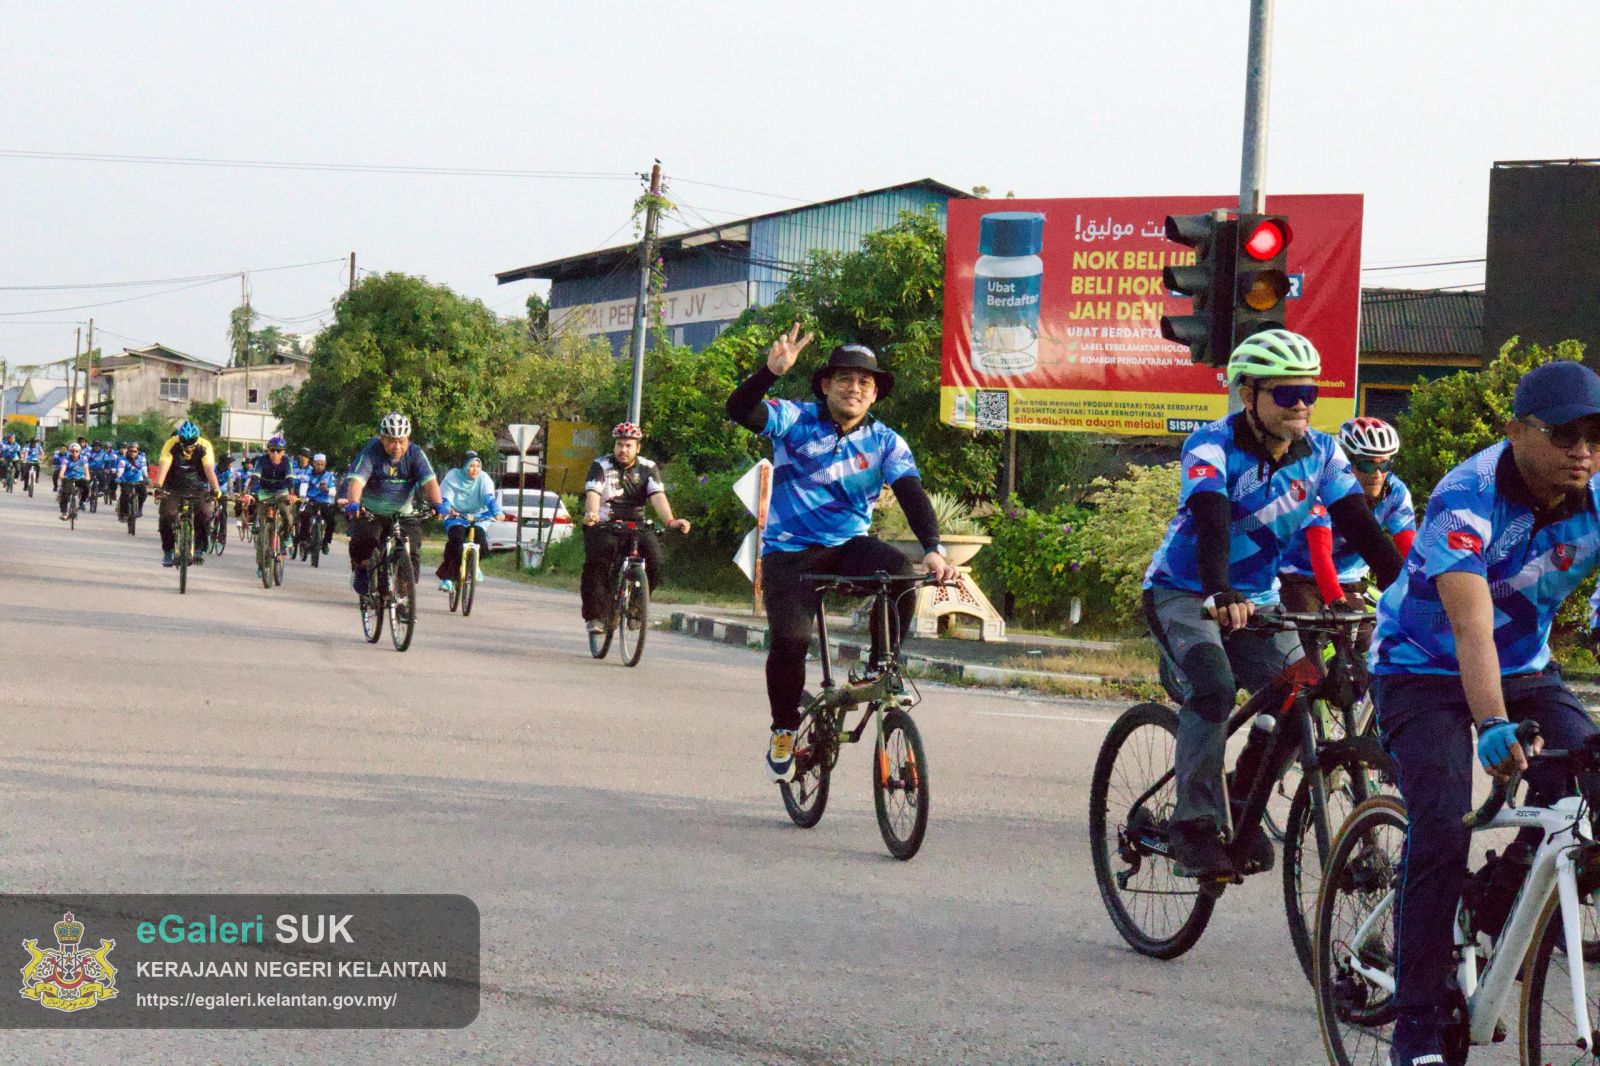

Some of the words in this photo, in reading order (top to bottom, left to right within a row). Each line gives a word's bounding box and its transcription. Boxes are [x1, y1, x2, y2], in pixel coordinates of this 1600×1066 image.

[1072, 251, 1120, 270] NOK
[1123, 251, 1166, 270] BELI
[987, 281, 1016, 293] Ubat
[1071, 276, 1113, 295] BELI
[1118, 276, 1164, 296] HOK
[685, 293, 706, 316] JV
[986, 294, 1039, 307] Berdaftar
[1068, 301, 1112, 320] JAH
[1116, 301, 1164, 321] DEH!
[1067, 327, 1099, 337] UBAT
[1101, 327, 1163, 339] BERDAFTA
[1081, 343, 1104, 351] LABEL
[1161, 345, 1192, 354] HOLOG
[1014, 415, 1034, 424] sila
[1085, 418, 1122, 428] aduan
[1124, 419, 1165, 430] melalui
